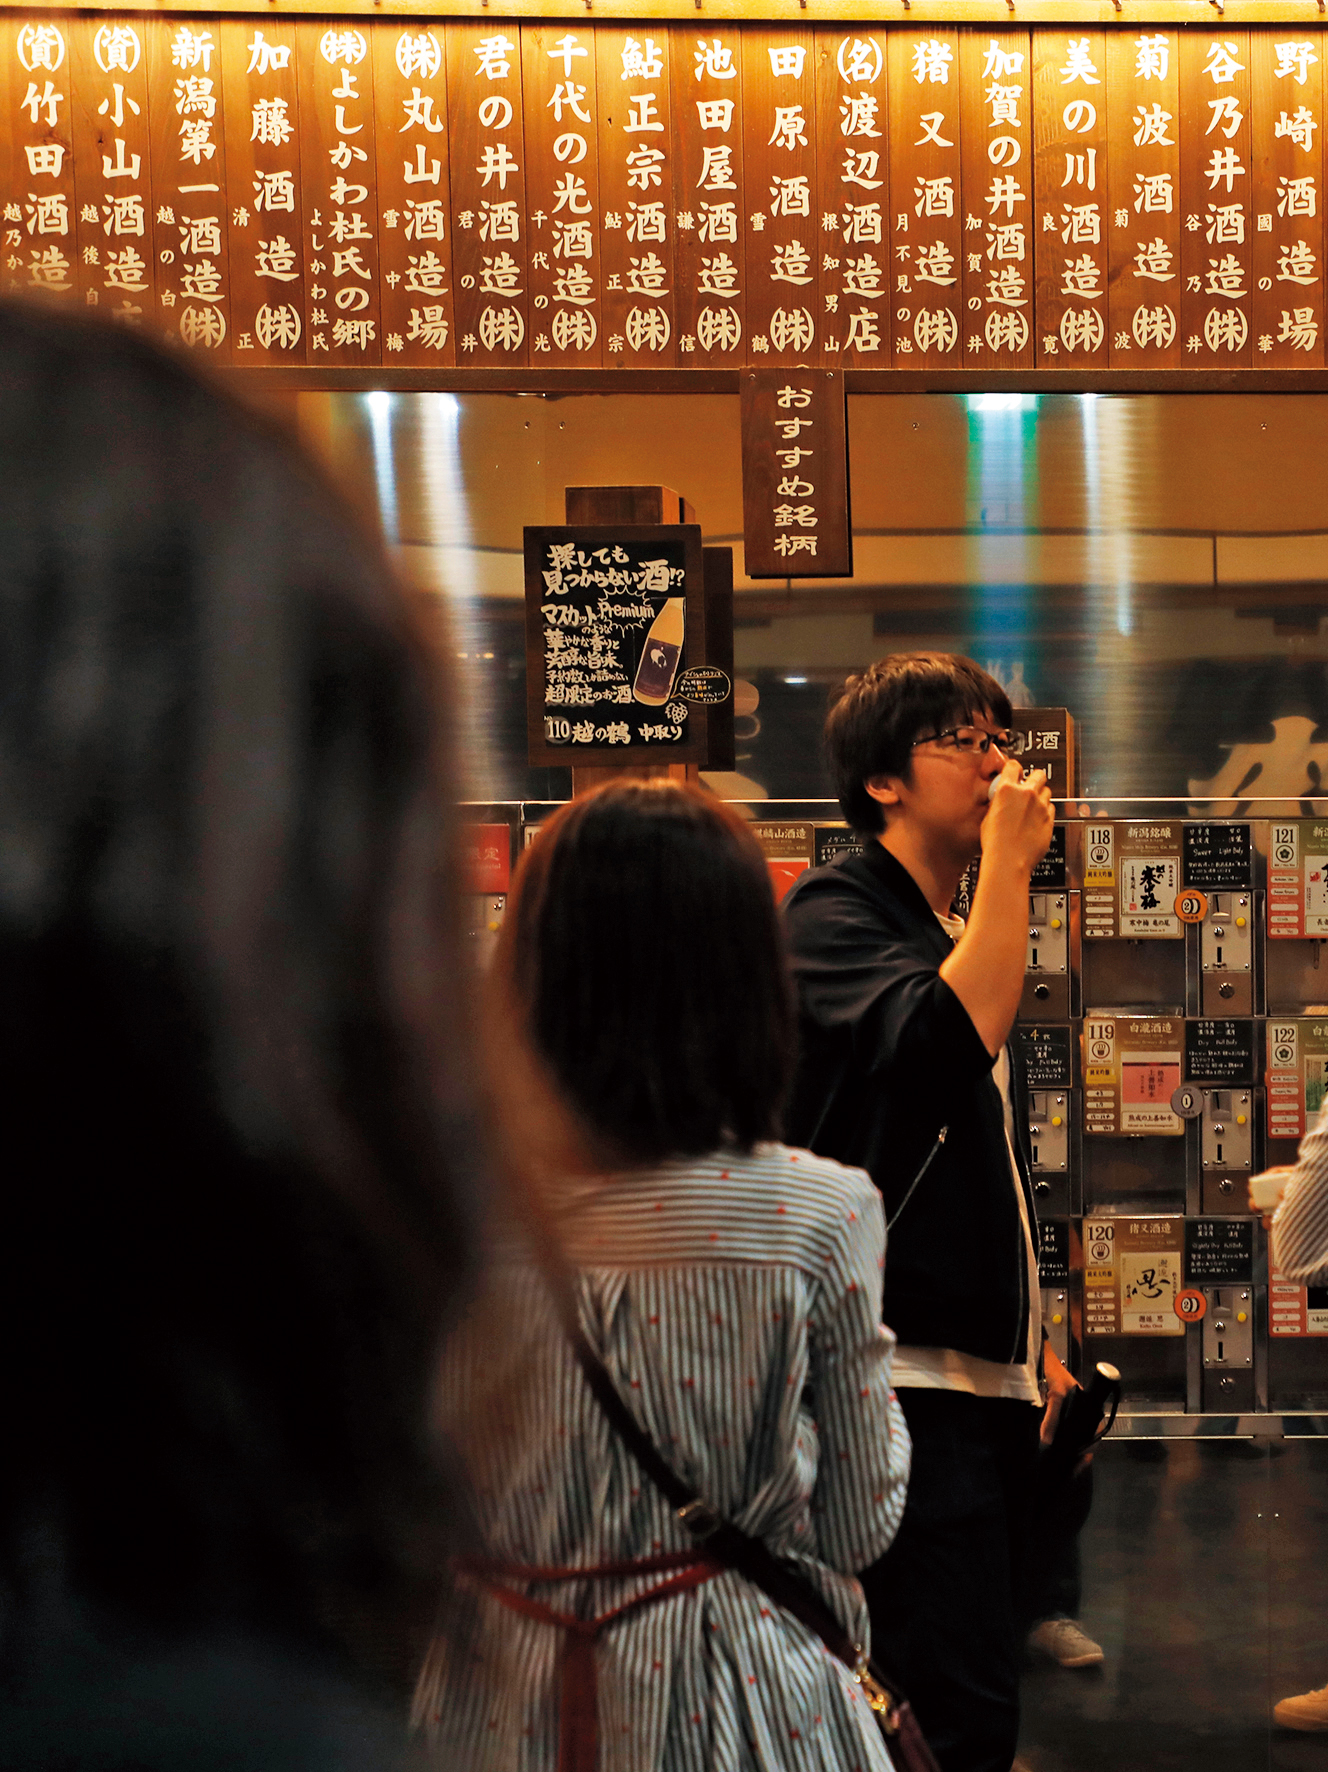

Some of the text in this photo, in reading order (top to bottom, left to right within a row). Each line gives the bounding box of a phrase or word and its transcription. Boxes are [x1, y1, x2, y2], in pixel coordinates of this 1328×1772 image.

[1273, 40, 1319, 353] 野崎酒造場
[232, 207, 254, 350] 清正
[309, 208, 328, 352] よしかわ杜氏
[382, 209, 404, 353] 雪中梅
[457, 210, 477, 353] 君の井
[531, 210, 551, 353] 千代の光
[604, 211, 624, 354] 鮎正宗
[677, 211, 695, 354] 謙信
[750, 213, 769, 354] 雪鶴
[821, 212, 840, 354] 根知男山
[895, 213, 913, 354] 月不見の池
[966, 213, 984, 353] 加賀の井
[1041, 213, 1059, 355] 良寛
[1114, 209, 1131, 351] 菊波
[1185, 214, 1203, 354] 谷乃井
[1257, 214, 1274, 353] 國の華
[773, 385, 819, 557] おすすめ銘柄
[540, 601, 656, 627] マスカット Premium
[547, 542, 629, 572] 探しても
[543, 627, 620, 652] 華やかな香りと
[572, 720, 632, 744] 越の鶴
[638, 723, 684, 742] 中取り
[1090, 829, 1110, 845] 118
[1276, 828, 1295, 844] 121
[1088, 1024, 1114, 1039] 119
[1274, 1028, 1295, 1043] 122
[1087, 1225, 1115, 1241] 120
